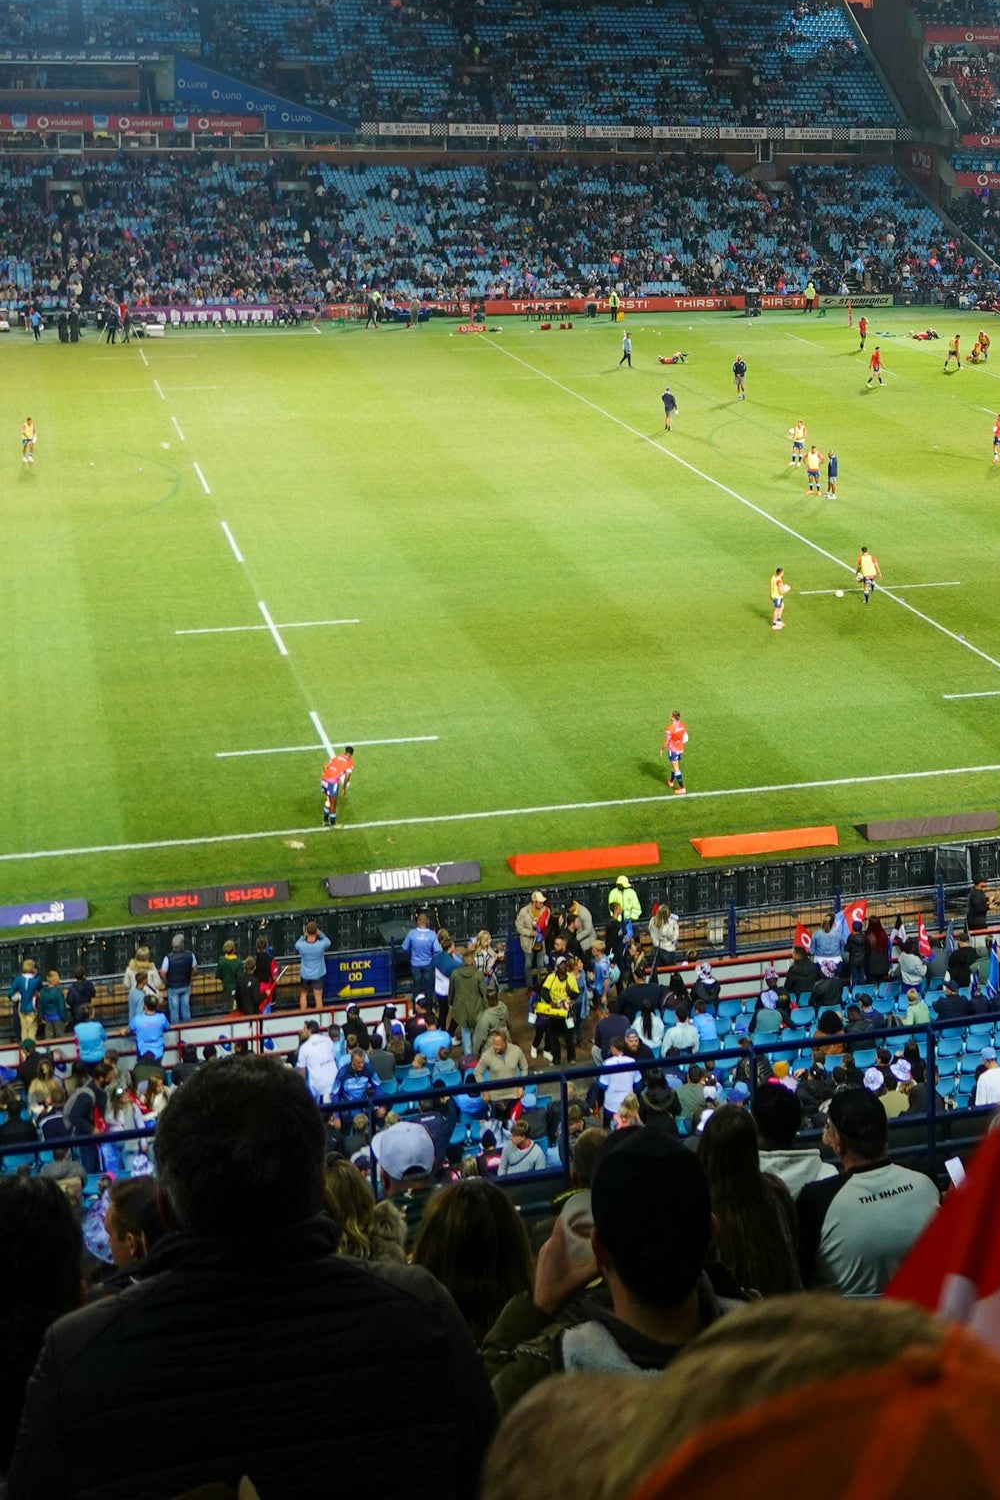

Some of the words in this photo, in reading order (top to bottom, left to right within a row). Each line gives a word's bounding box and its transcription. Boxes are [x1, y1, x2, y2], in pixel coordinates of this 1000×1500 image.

[596, 301, 647, 310] THRSTI
[674, 300, 727, 309] THIRSTI
[761, 299, 805, 308] HIRSTI
[369, 867, 421, 892] PUMA
[148, 894, 199, 909] ISUZU
[224, 887, 275, 901] ISUZU
[19, 911, 64, 925] AFGRI
[339, 960, 371, 971] BLOCK
[859, 1194, 877, 1204] THE
[879, 1183, 914, 1199] SHARKS
